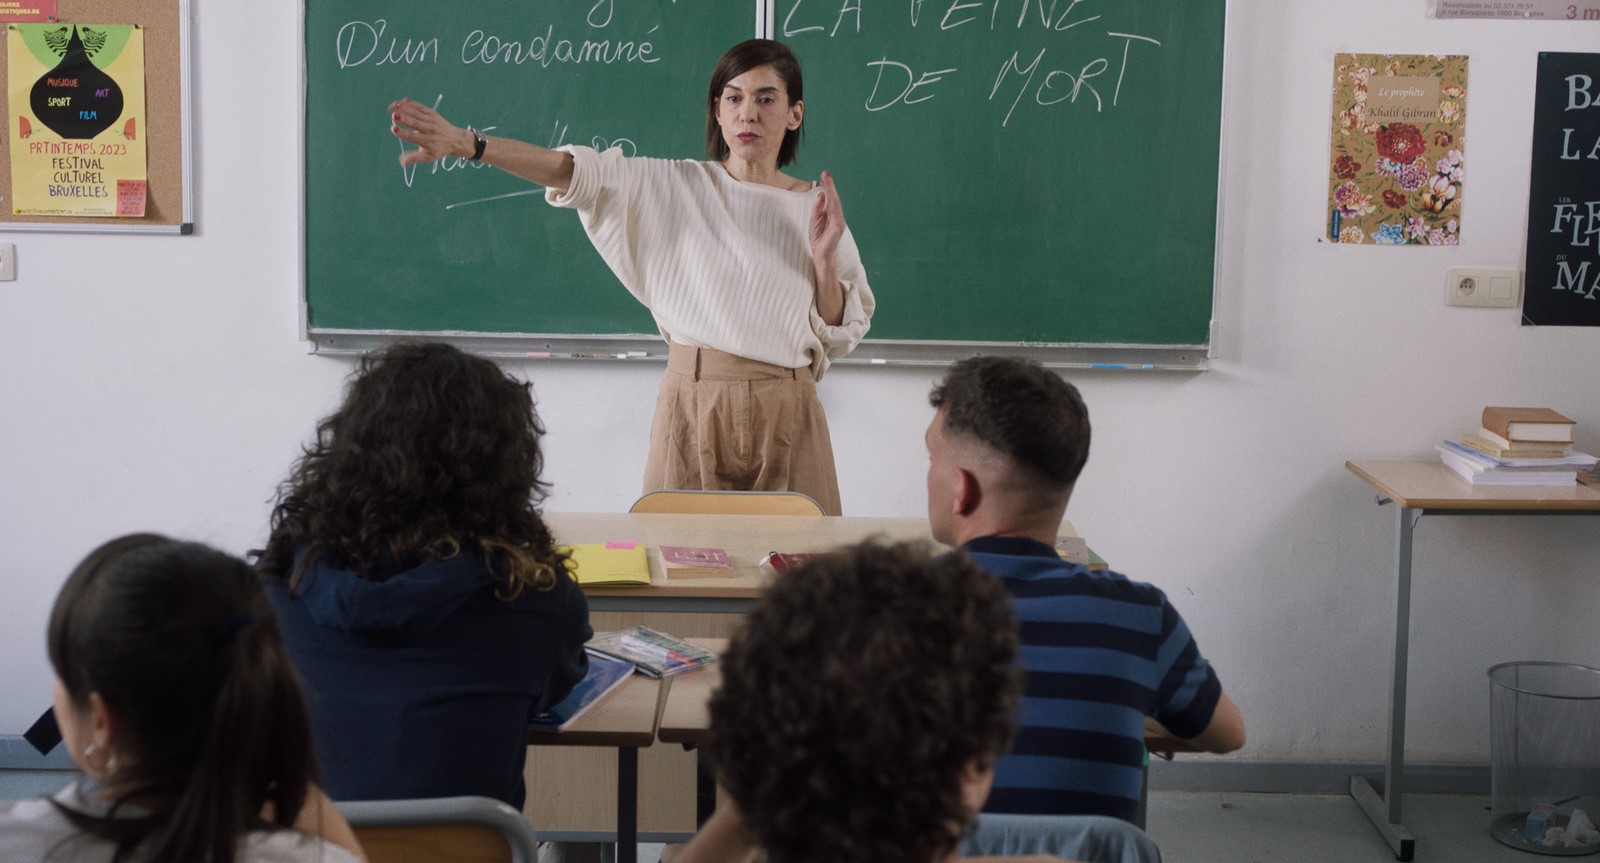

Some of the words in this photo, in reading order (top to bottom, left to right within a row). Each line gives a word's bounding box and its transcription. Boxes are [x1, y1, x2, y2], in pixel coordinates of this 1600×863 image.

[1566, 4, 1578, 20] 3
[337, 19, 438, 69] D'un
[461, 24, 661, 68] condamné
[47, 77, 79, 88] MUSIQUE
[865, 56, 958, 112] DE
[989, 31, 1161, 127] MORT
[95, 88, 110, 98] ART
[1378, 87, 1390, 97] Le
[1390, 86, 1425, 100] prophète
[48, 96, 72, 108] SPORT
[80, 110, 98, 120] FILM
[1368, 105, 1400, 118] Khalil
[1402, 105, 1436, 120] Gibran
[99, 144, 127, 156] 2023
[52, 156, 104, 170] FESTIVAL
[54, 170, 104, 184] CULTUREL
[48, 184, 108, 198] BRUXELLES
